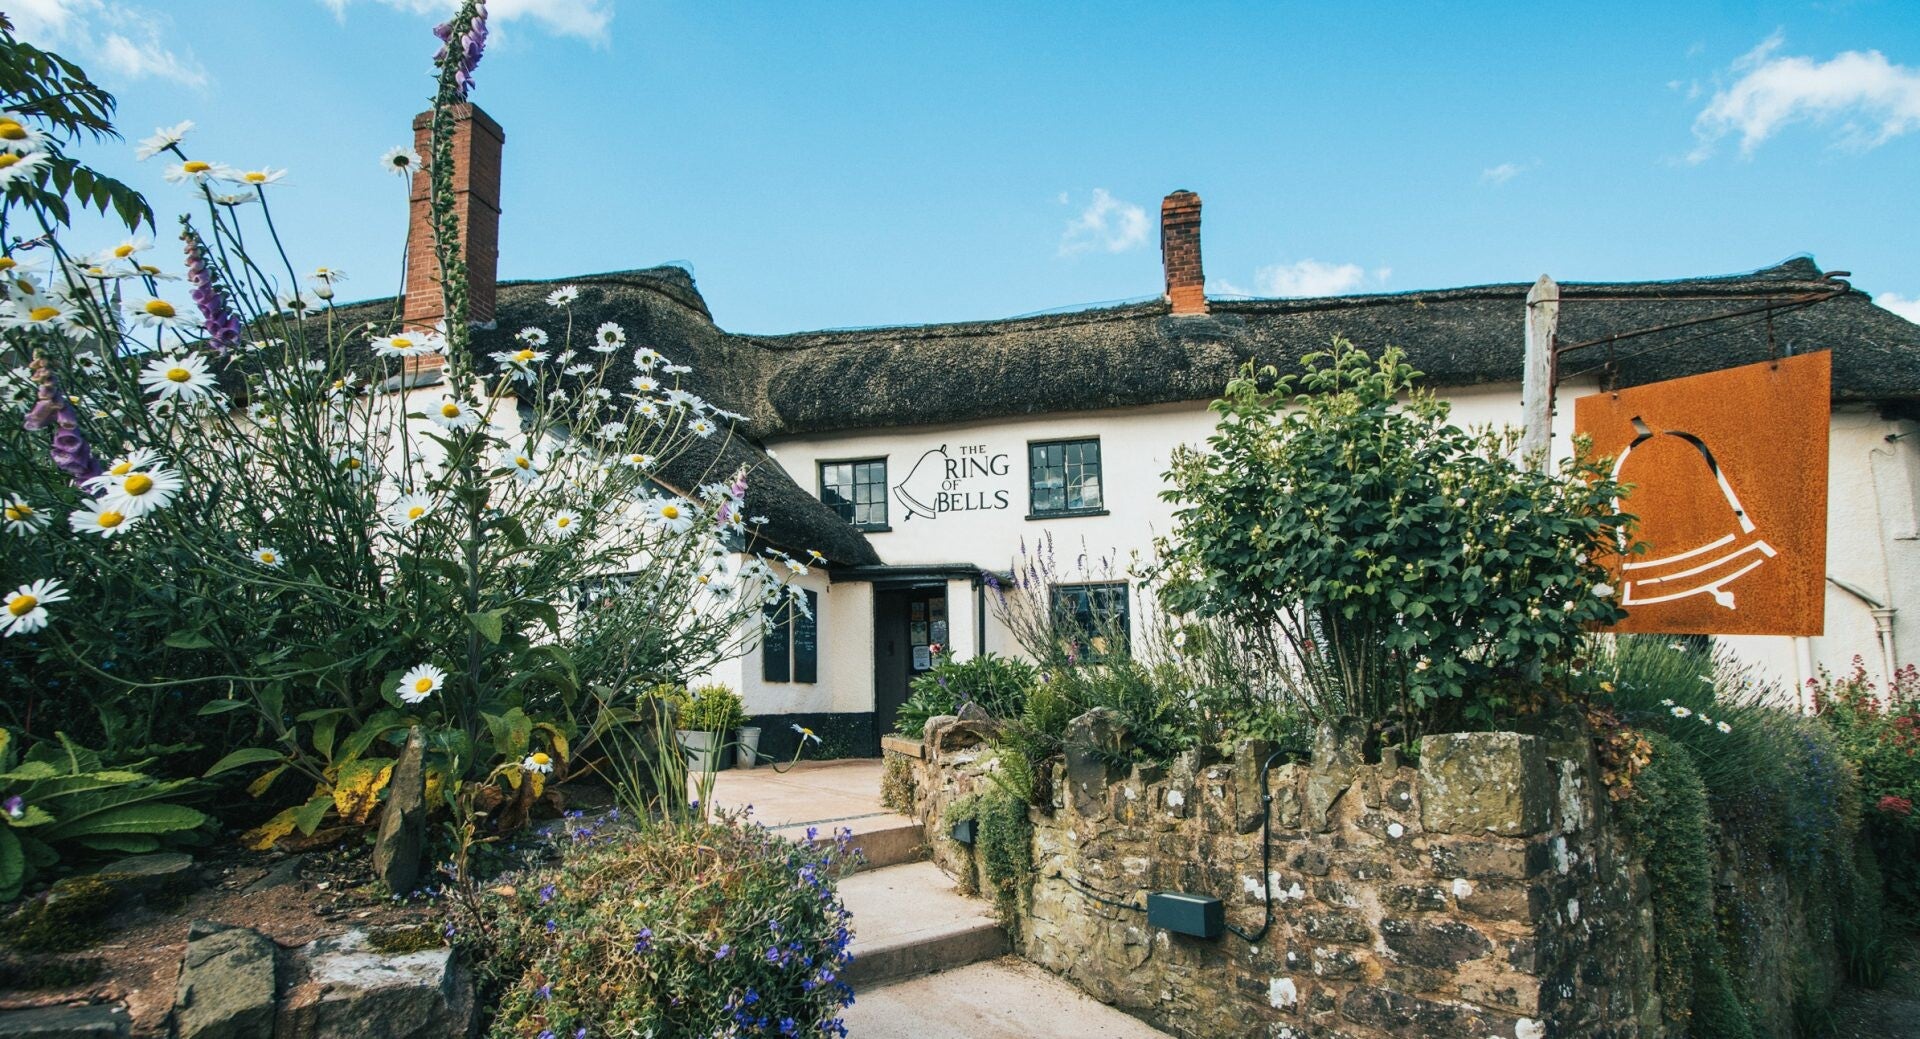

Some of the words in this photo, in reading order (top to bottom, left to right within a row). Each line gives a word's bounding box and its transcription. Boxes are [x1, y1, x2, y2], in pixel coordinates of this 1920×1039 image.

[960, 444, 987, 455] THE
[944, 454, 1010, 479] RING
[942, 479, 961, 491] OF
[937, 490, 1009, 513] BELLS
